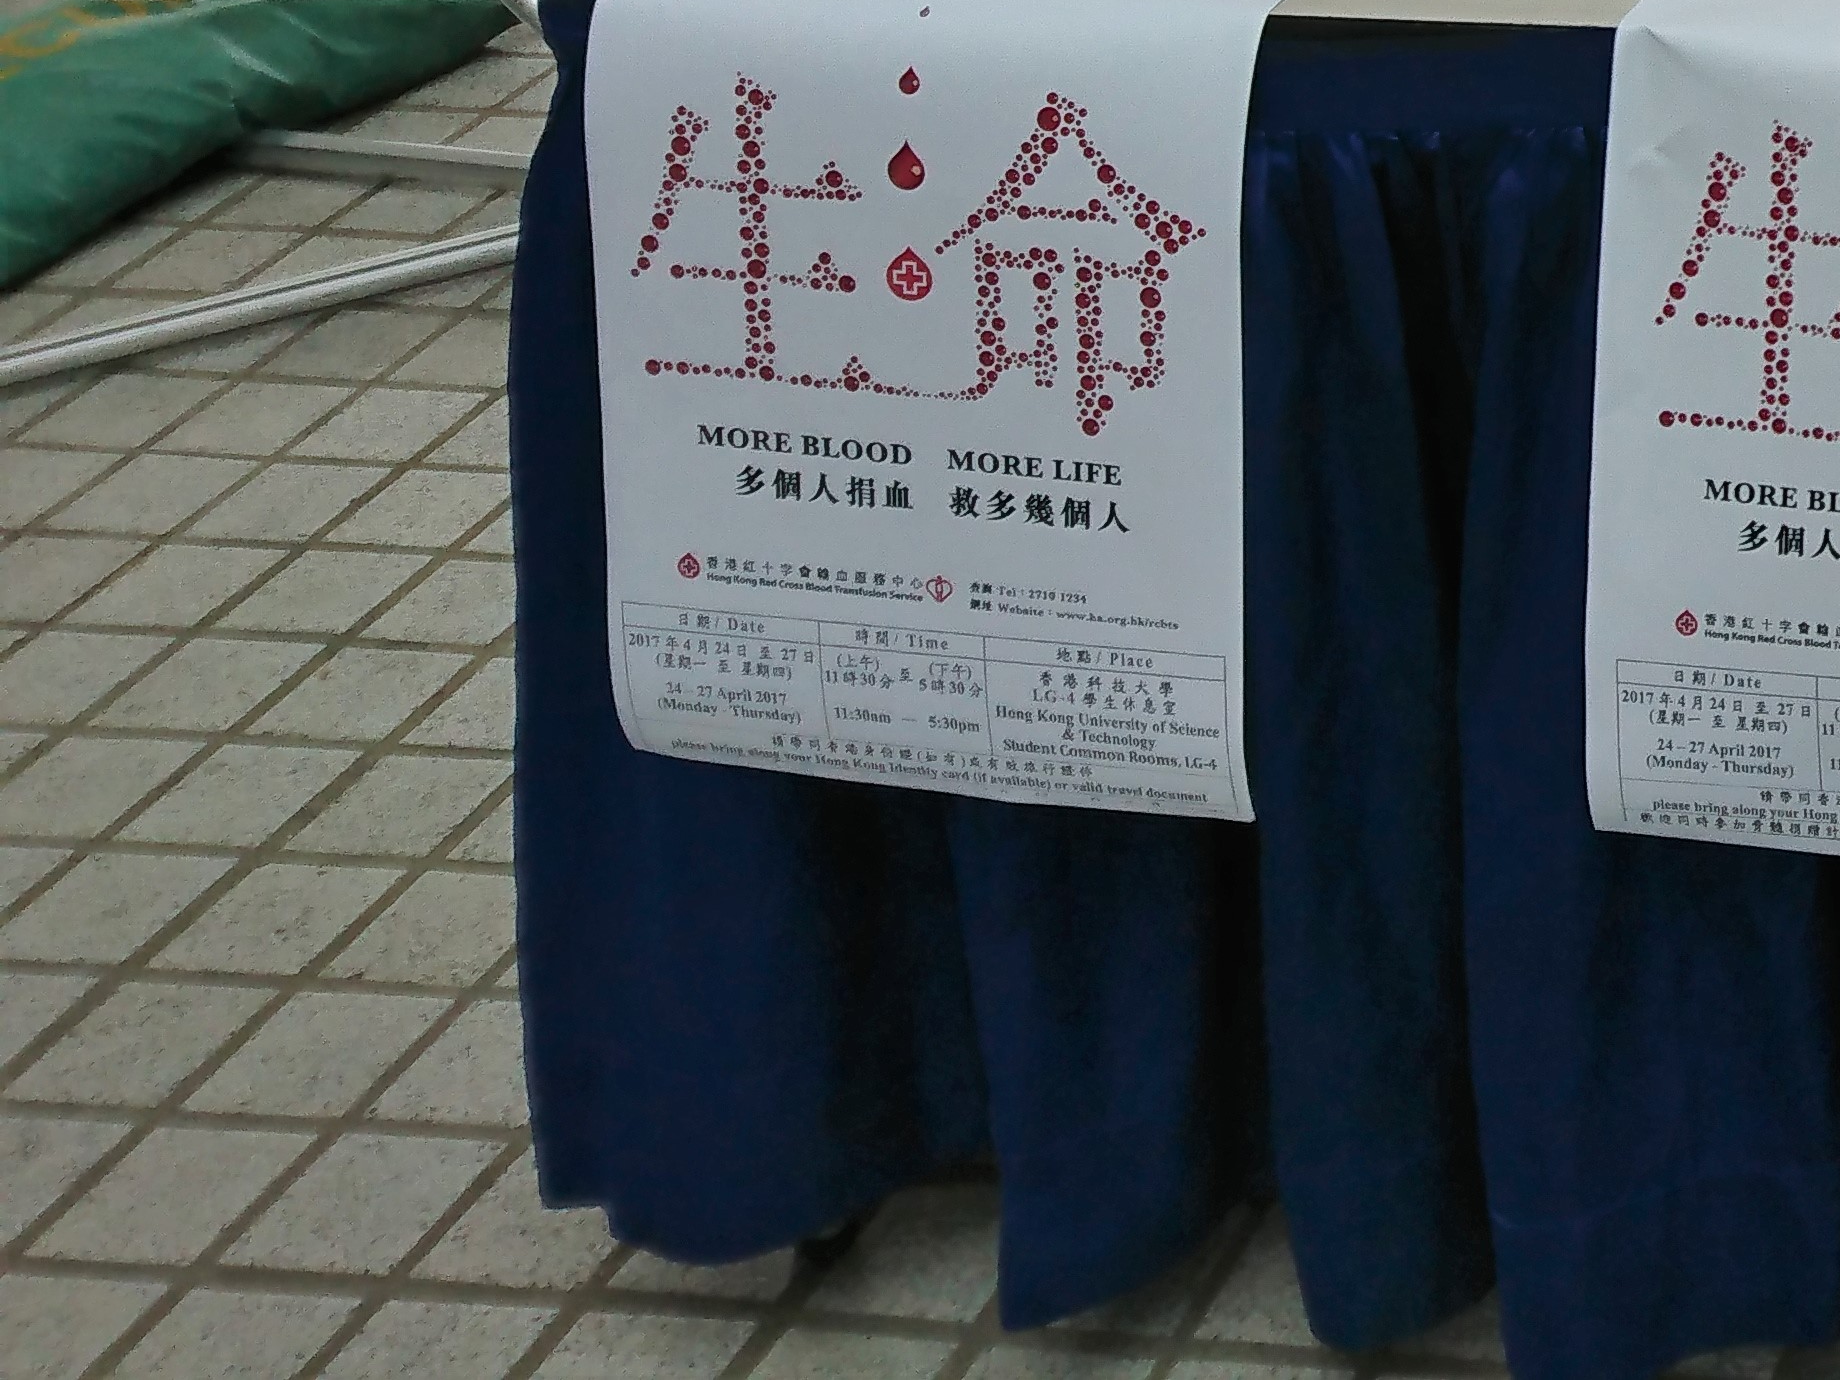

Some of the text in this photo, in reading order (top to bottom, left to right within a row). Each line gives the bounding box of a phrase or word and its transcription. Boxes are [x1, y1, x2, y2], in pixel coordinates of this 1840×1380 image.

[630, 70, 1209, 438] 生命
[697, 425, 1121, 485] MORE BLOOD MORE LIFE
[736, 465, 1129, 533] 多個人捐血 救多幾個人
[1704, 479, 1797, 508] MORE
